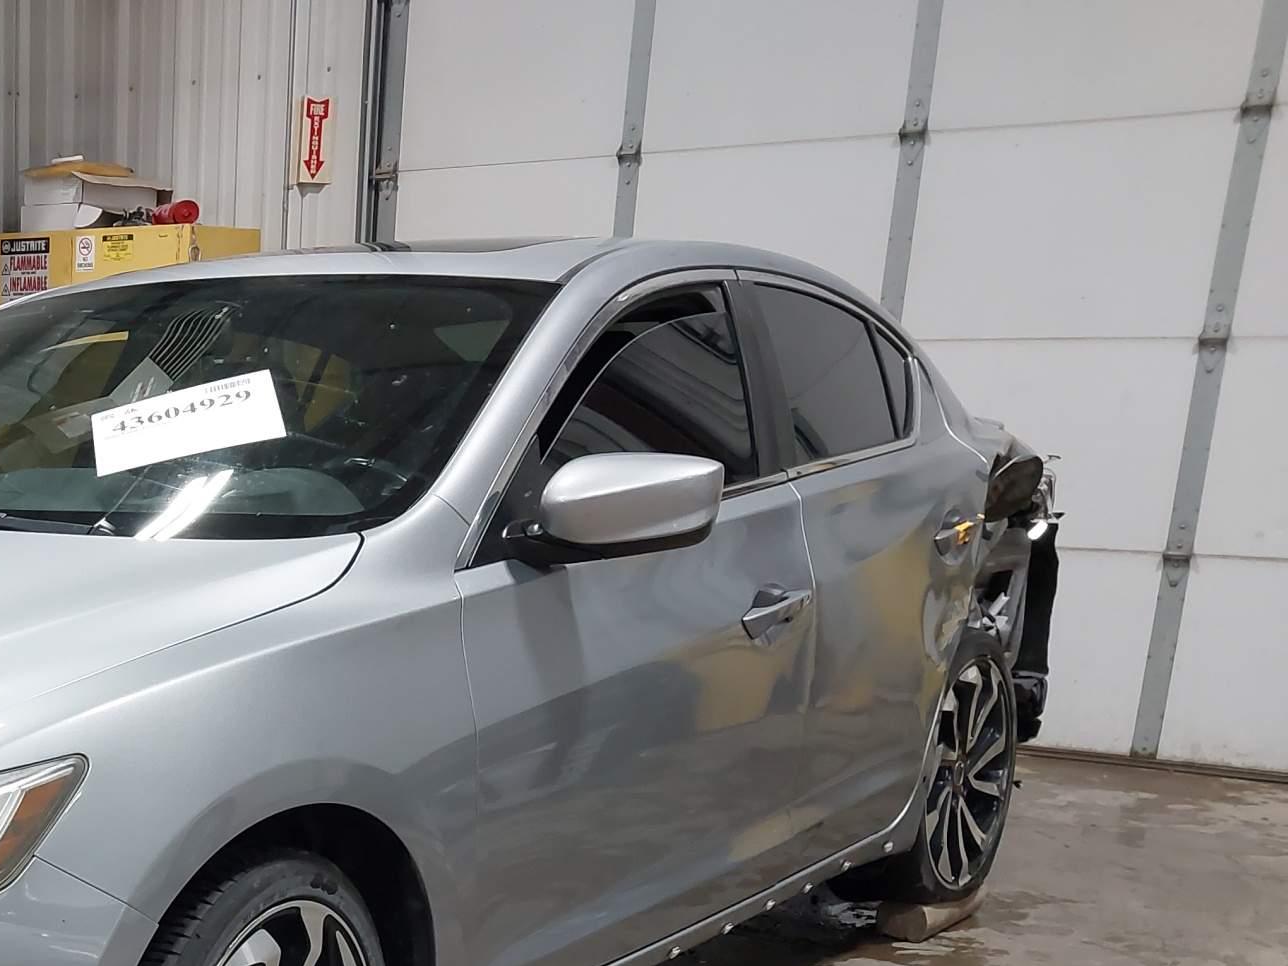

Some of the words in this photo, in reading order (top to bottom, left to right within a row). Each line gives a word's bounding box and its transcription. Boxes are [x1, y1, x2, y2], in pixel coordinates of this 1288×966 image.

[10, 239, 47, 252] JUSTRITE
[9, 254, 48, 272] FLAMMABLE
[9, 275, 48, 293] INFLAMABLE
[112, 390, 251, 432] 43604929
